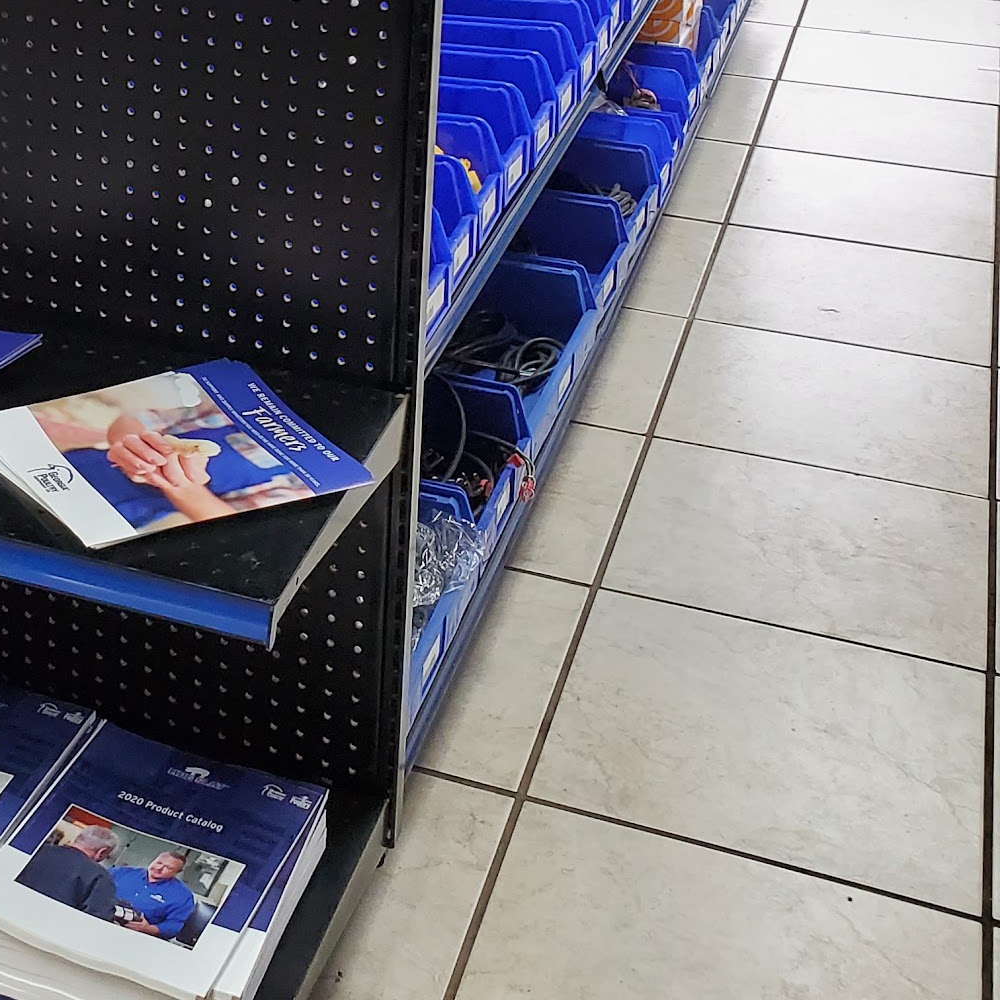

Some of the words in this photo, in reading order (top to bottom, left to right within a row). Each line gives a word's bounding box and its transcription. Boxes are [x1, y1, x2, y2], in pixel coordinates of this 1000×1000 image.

[242, 406, 308, 452] Farmers
[247, 382, 260, 393] WE
[257, 392, 283, 416] REMAIN
[279, 414, 316, 444] COMMITTED
[314, 442, 325, 451] TO
[322, 449, 340, 462] OUR
[117, 790, 144, 806] 2020
[145, 800, 184, 820] Product
[185, 814, 224, 833] Catalog
